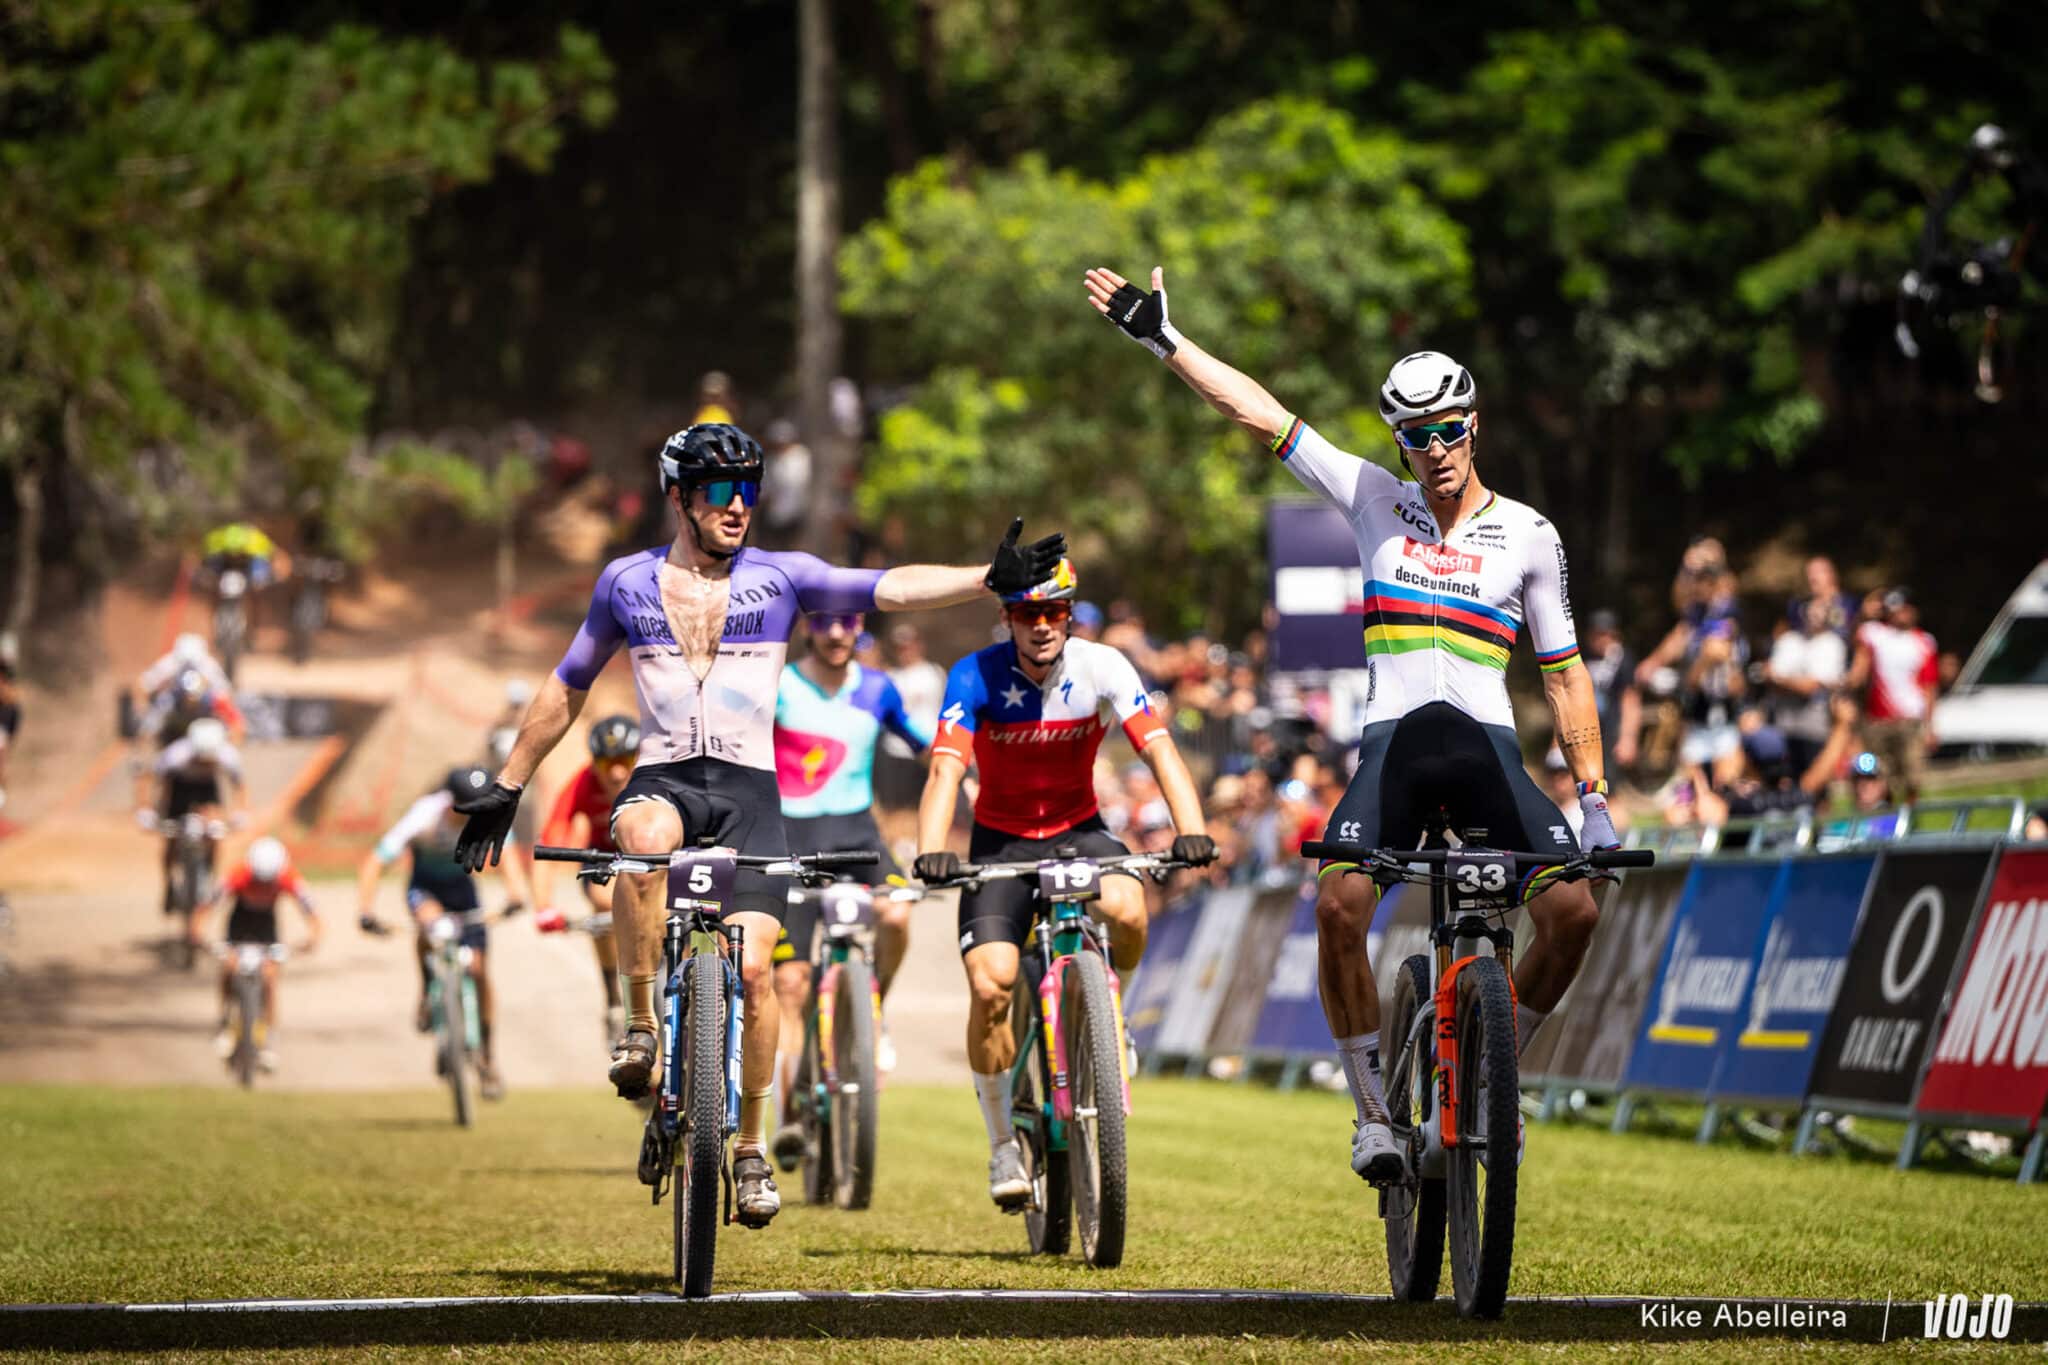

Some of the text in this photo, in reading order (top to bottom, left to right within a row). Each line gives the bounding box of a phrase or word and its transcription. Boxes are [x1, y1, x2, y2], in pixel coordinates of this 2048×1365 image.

[1401, 508, 1436, 538] UCI
[1409, 542, 1473, 570] Alpecin
[1395, 565, 1481, 599] deceuninck
[687, 864, 713, 894] 5
[1050, 861, 1094, 889] 19
[1456, 863, 1507, 894] 33
[1838, 1015, 1922, 1072] OAKLEY
